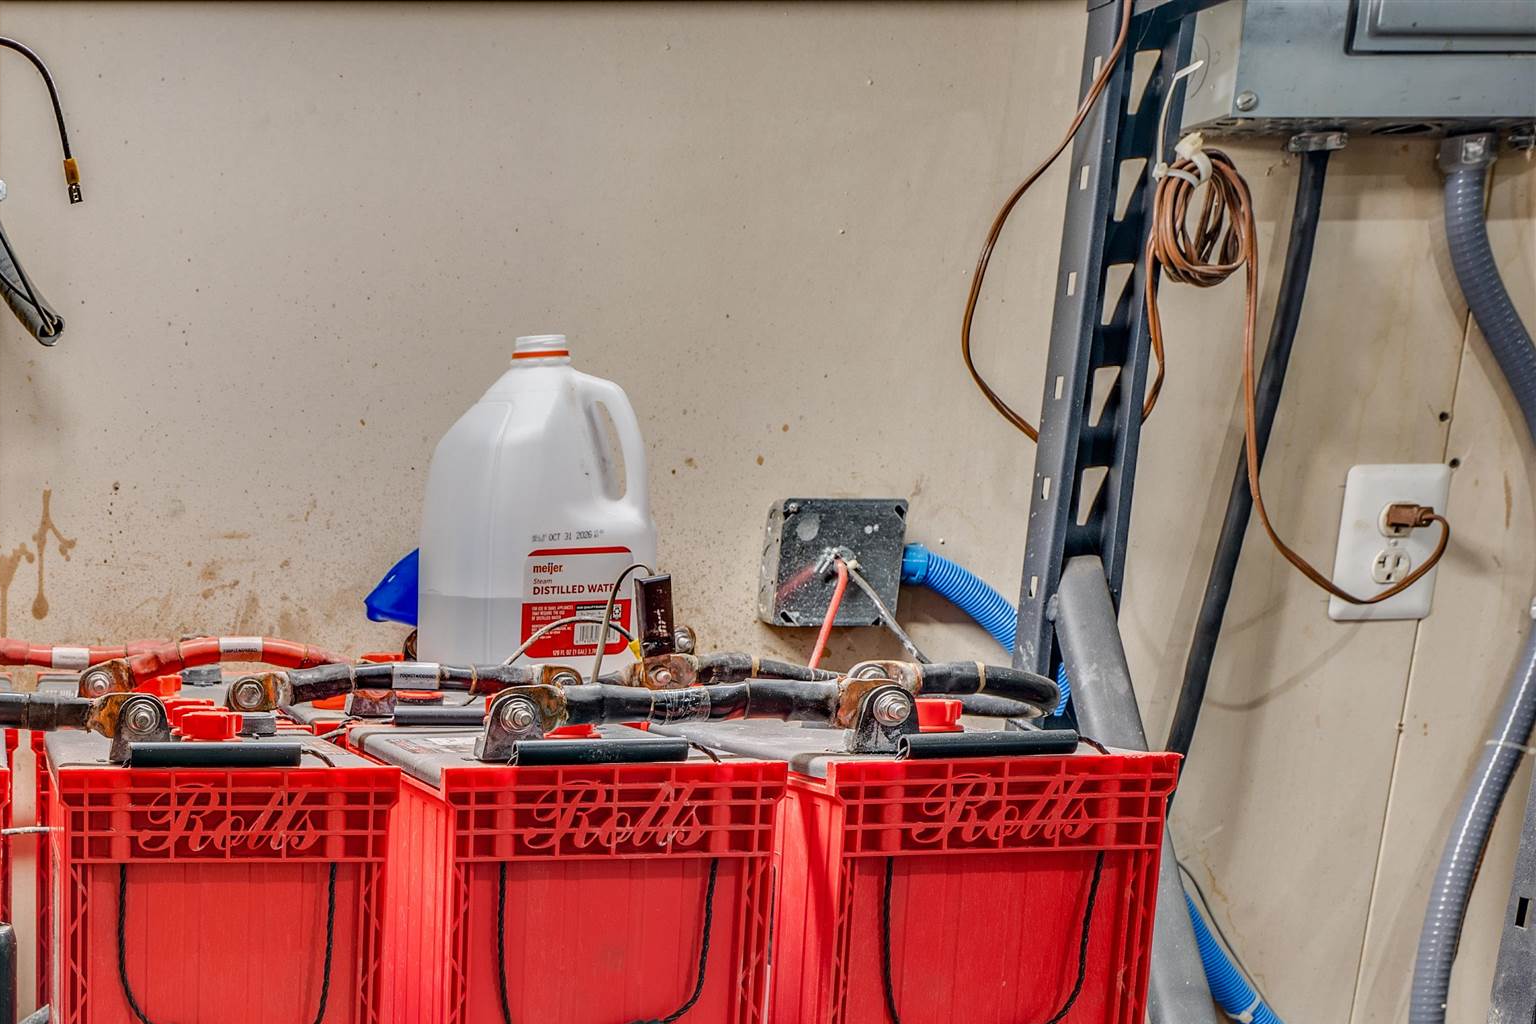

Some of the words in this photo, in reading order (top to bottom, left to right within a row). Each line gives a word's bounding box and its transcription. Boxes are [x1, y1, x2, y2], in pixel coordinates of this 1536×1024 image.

[533, 563, 563, 575] meijer
[533, 585, 585, 595] DISTILLED
[138, 783, 321, 851] Rolls
[523, 780, 706, 849] Rolls
[911, 772, 1096, 843] Rolls
